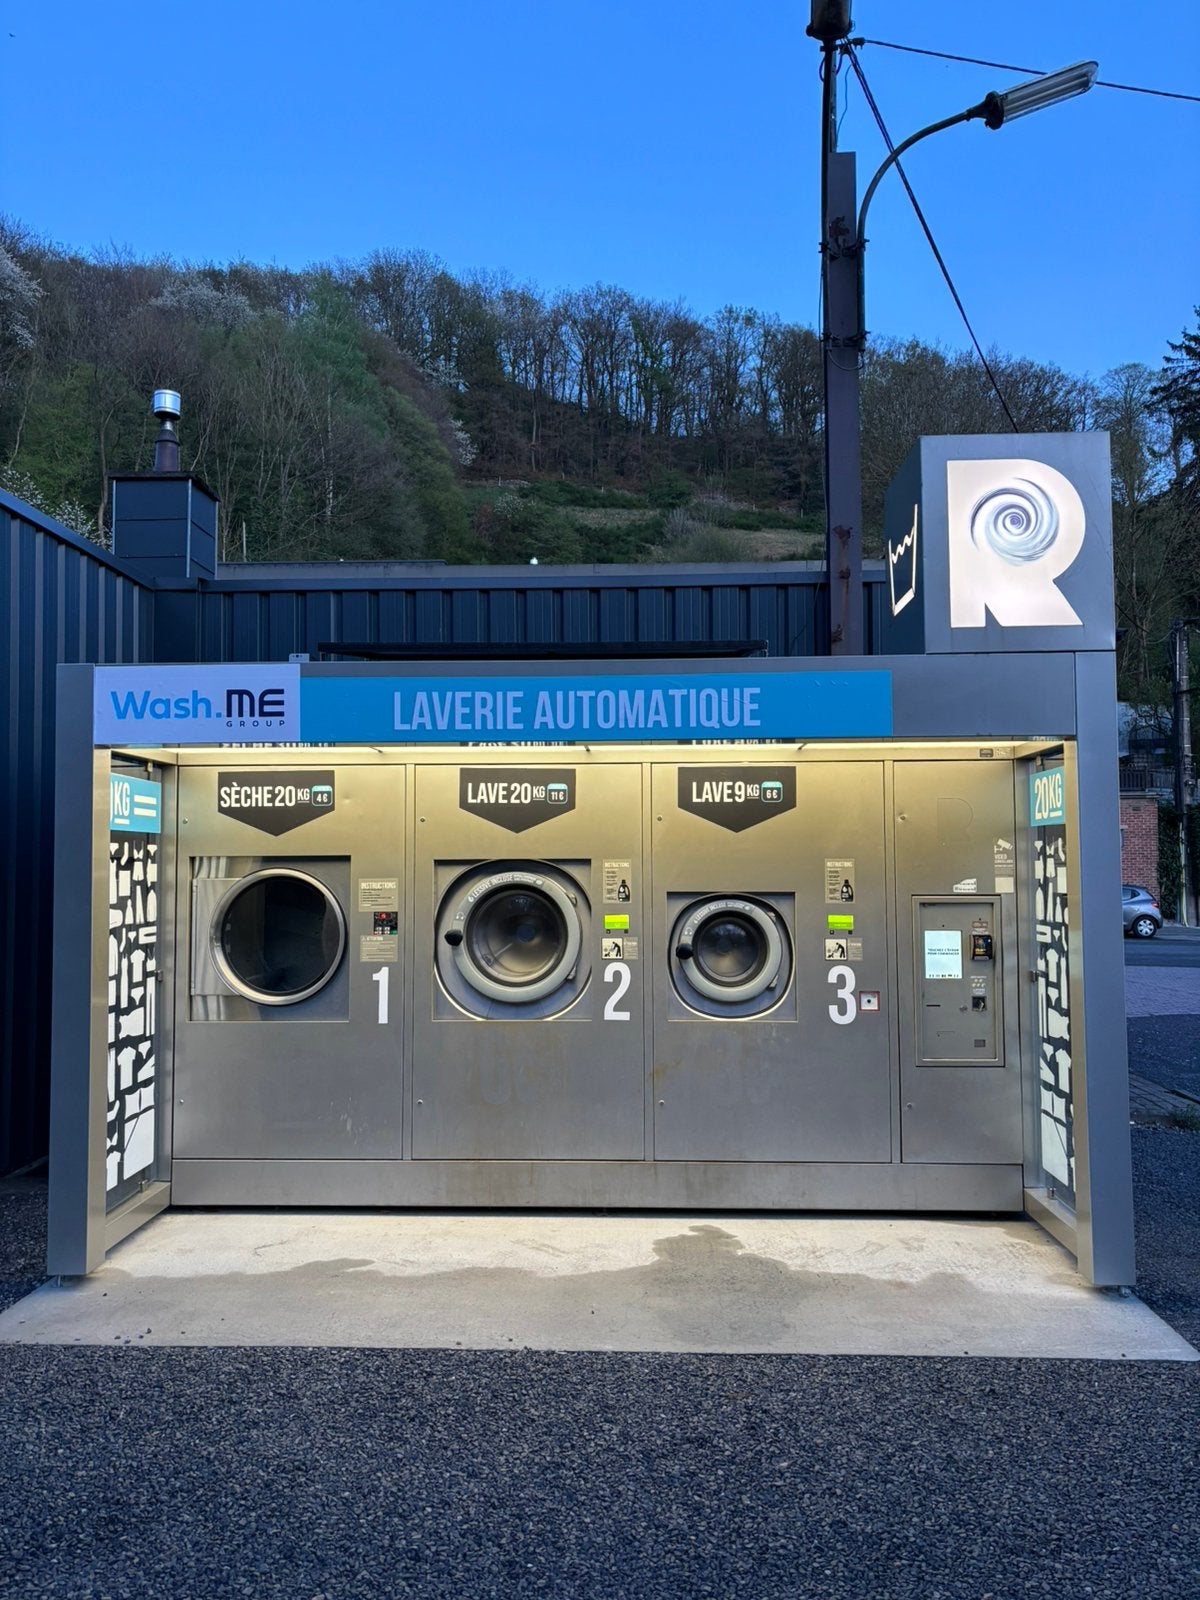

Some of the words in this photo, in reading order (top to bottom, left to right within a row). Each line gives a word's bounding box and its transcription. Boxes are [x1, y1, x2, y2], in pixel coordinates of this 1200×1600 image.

[226, 720, 285, 728] GROUP
[394, 690, 524, 730] LAVERIE
[533, 687, 761, 729] AUTOMATIQUE
[110, 779, 131, 821] KG
[467, 782, 508, 804] LAVE
[692, 781, 734, 803] LAVE
[372, 966, 389, 1024] 1
[604, 962, 631, 1021] 2
[827, 965, 857, 1025] 3
